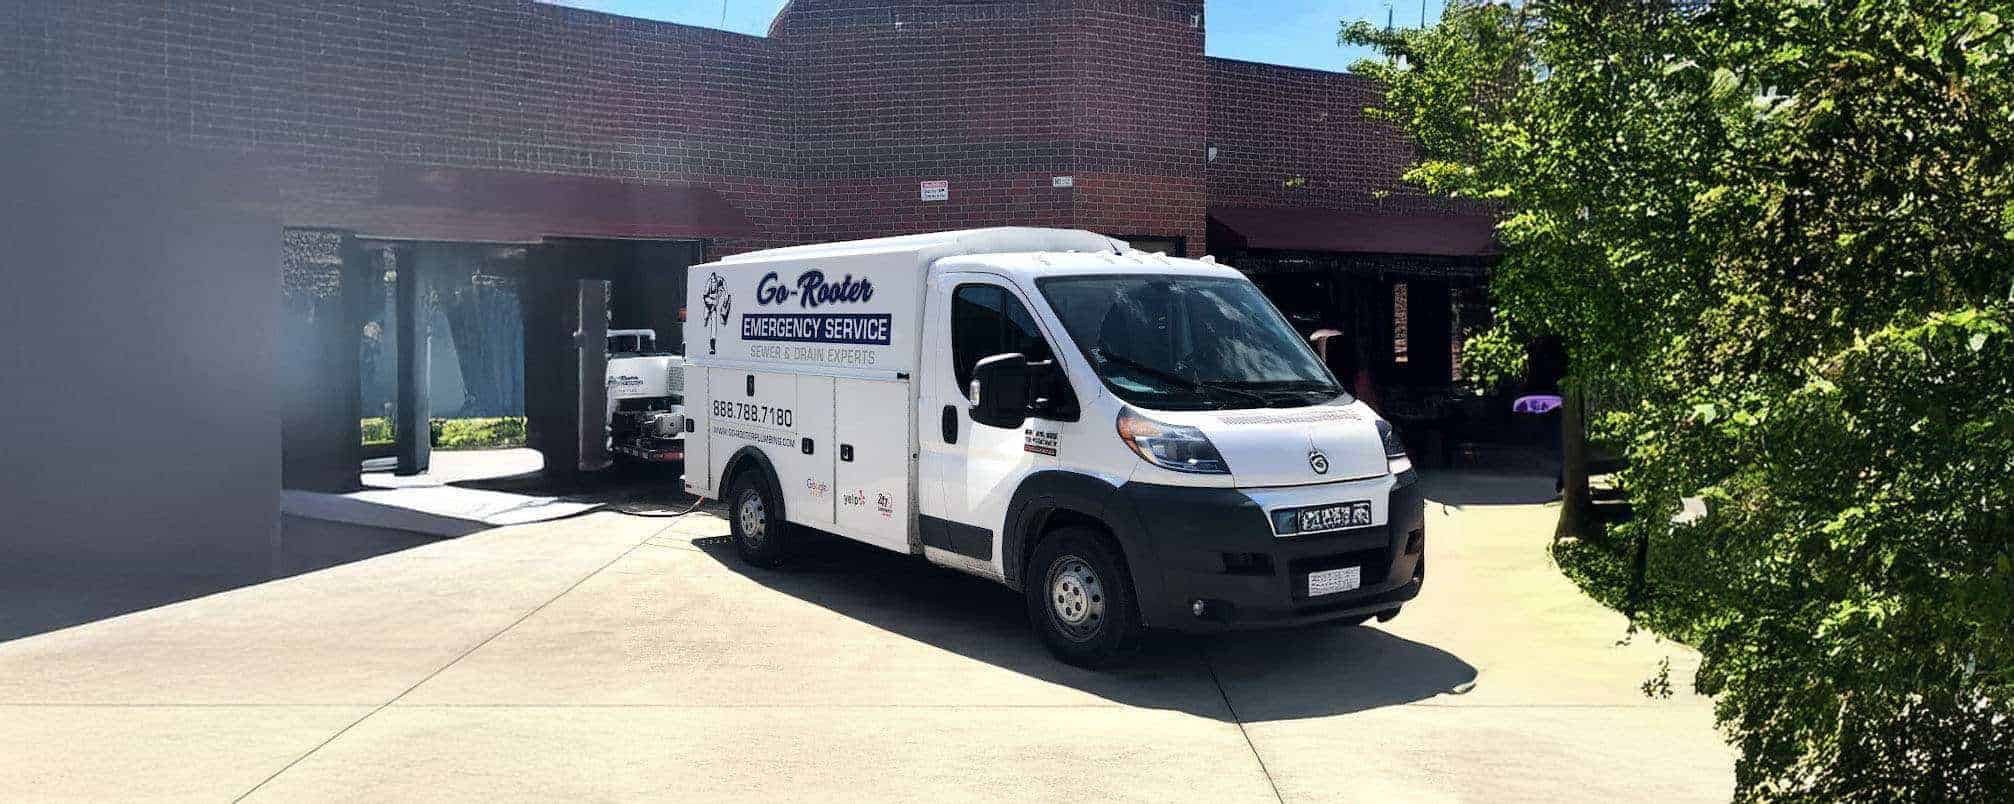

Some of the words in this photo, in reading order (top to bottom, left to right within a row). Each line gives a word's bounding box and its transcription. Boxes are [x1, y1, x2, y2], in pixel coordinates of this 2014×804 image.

[757, 269, 874, 308] Go-Rooter
[744, 318, 821, 338] EMERGENCY
[825, 318, 887, 340] SERVICE
[751, 344, 781, 359] SEWER
[785, 346, 790, 360] &
[794, 347, 824, 361] DRAIN
[828, 348, 875, 365] EXPERTS
[713, 401, 792, 427] 888.788.7180
